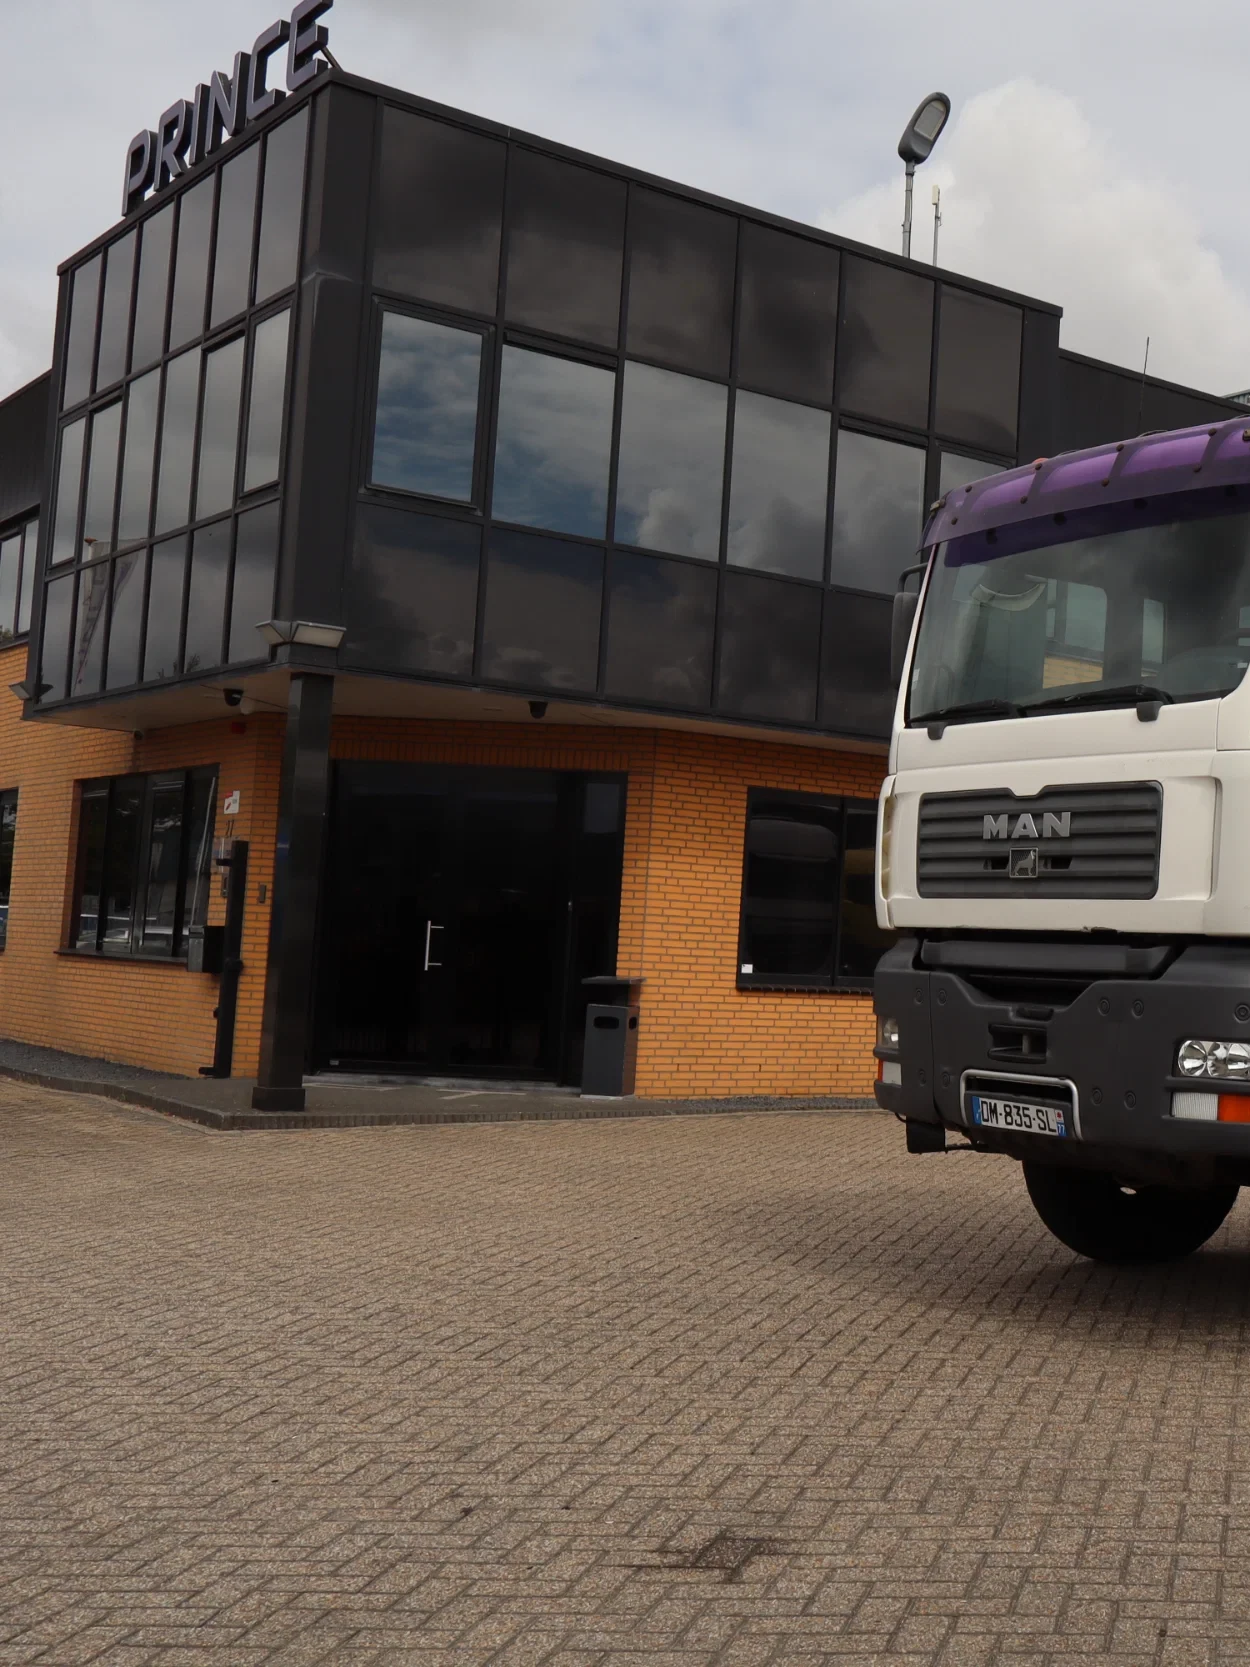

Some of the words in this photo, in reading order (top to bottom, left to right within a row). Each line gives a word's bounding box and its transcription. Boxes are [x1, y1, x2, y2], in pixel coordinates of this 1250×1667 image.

[122, 0, 333, 216] PRINCE
[983, 811, 1071, 839] MAN
[981, 1100, 1057, 1133] DM-835-SL
